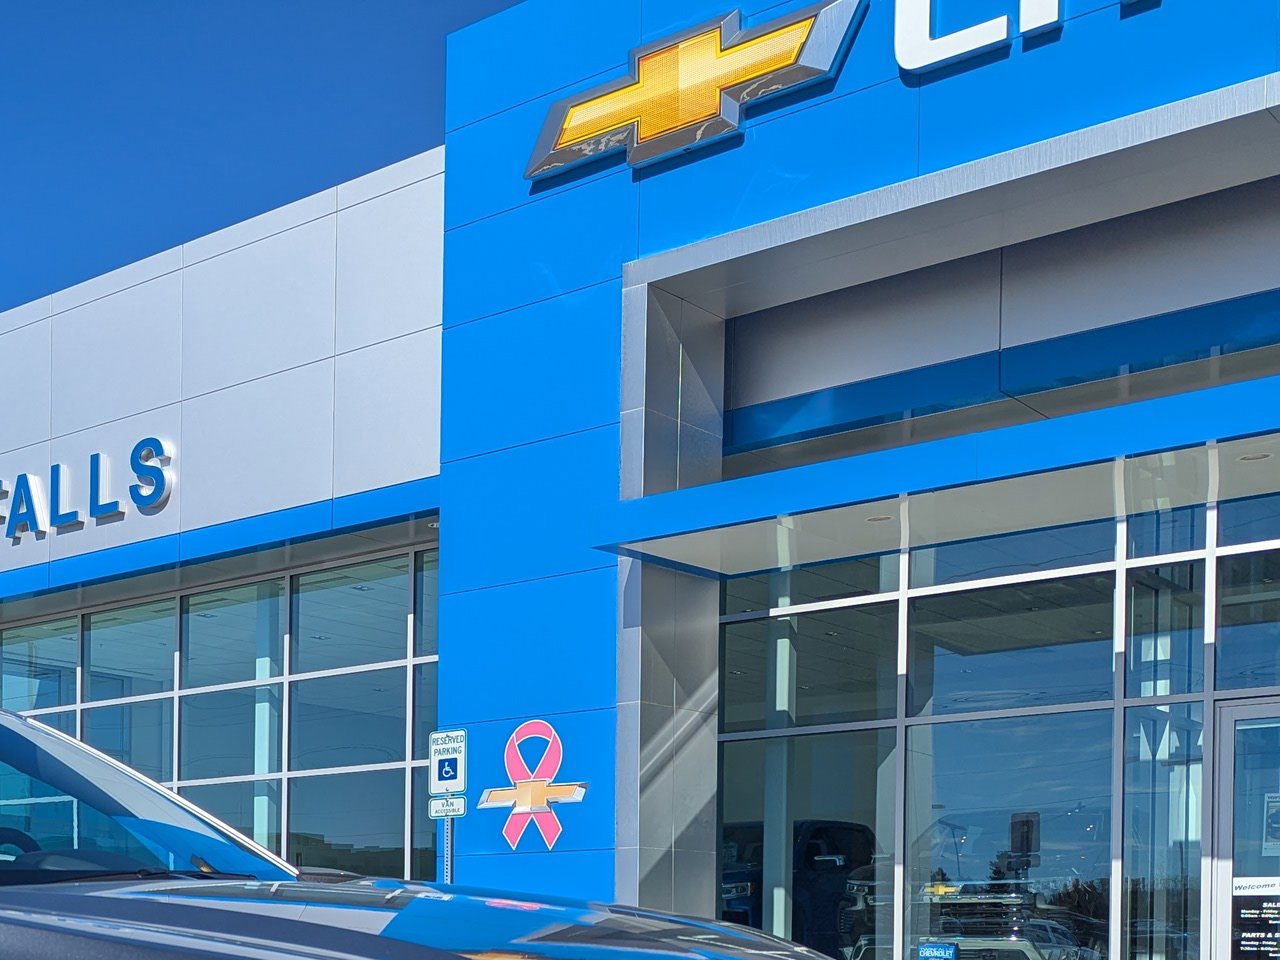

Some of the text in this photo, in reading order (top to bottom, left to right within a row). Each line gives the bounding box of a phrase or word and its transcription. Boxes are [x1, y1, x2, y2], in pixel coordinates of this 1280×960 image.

[432, 735, 465, 746] RESERVED
[434, 746, 462, 756] PARKING
[1234, 883, 1276, 891] Welcome
